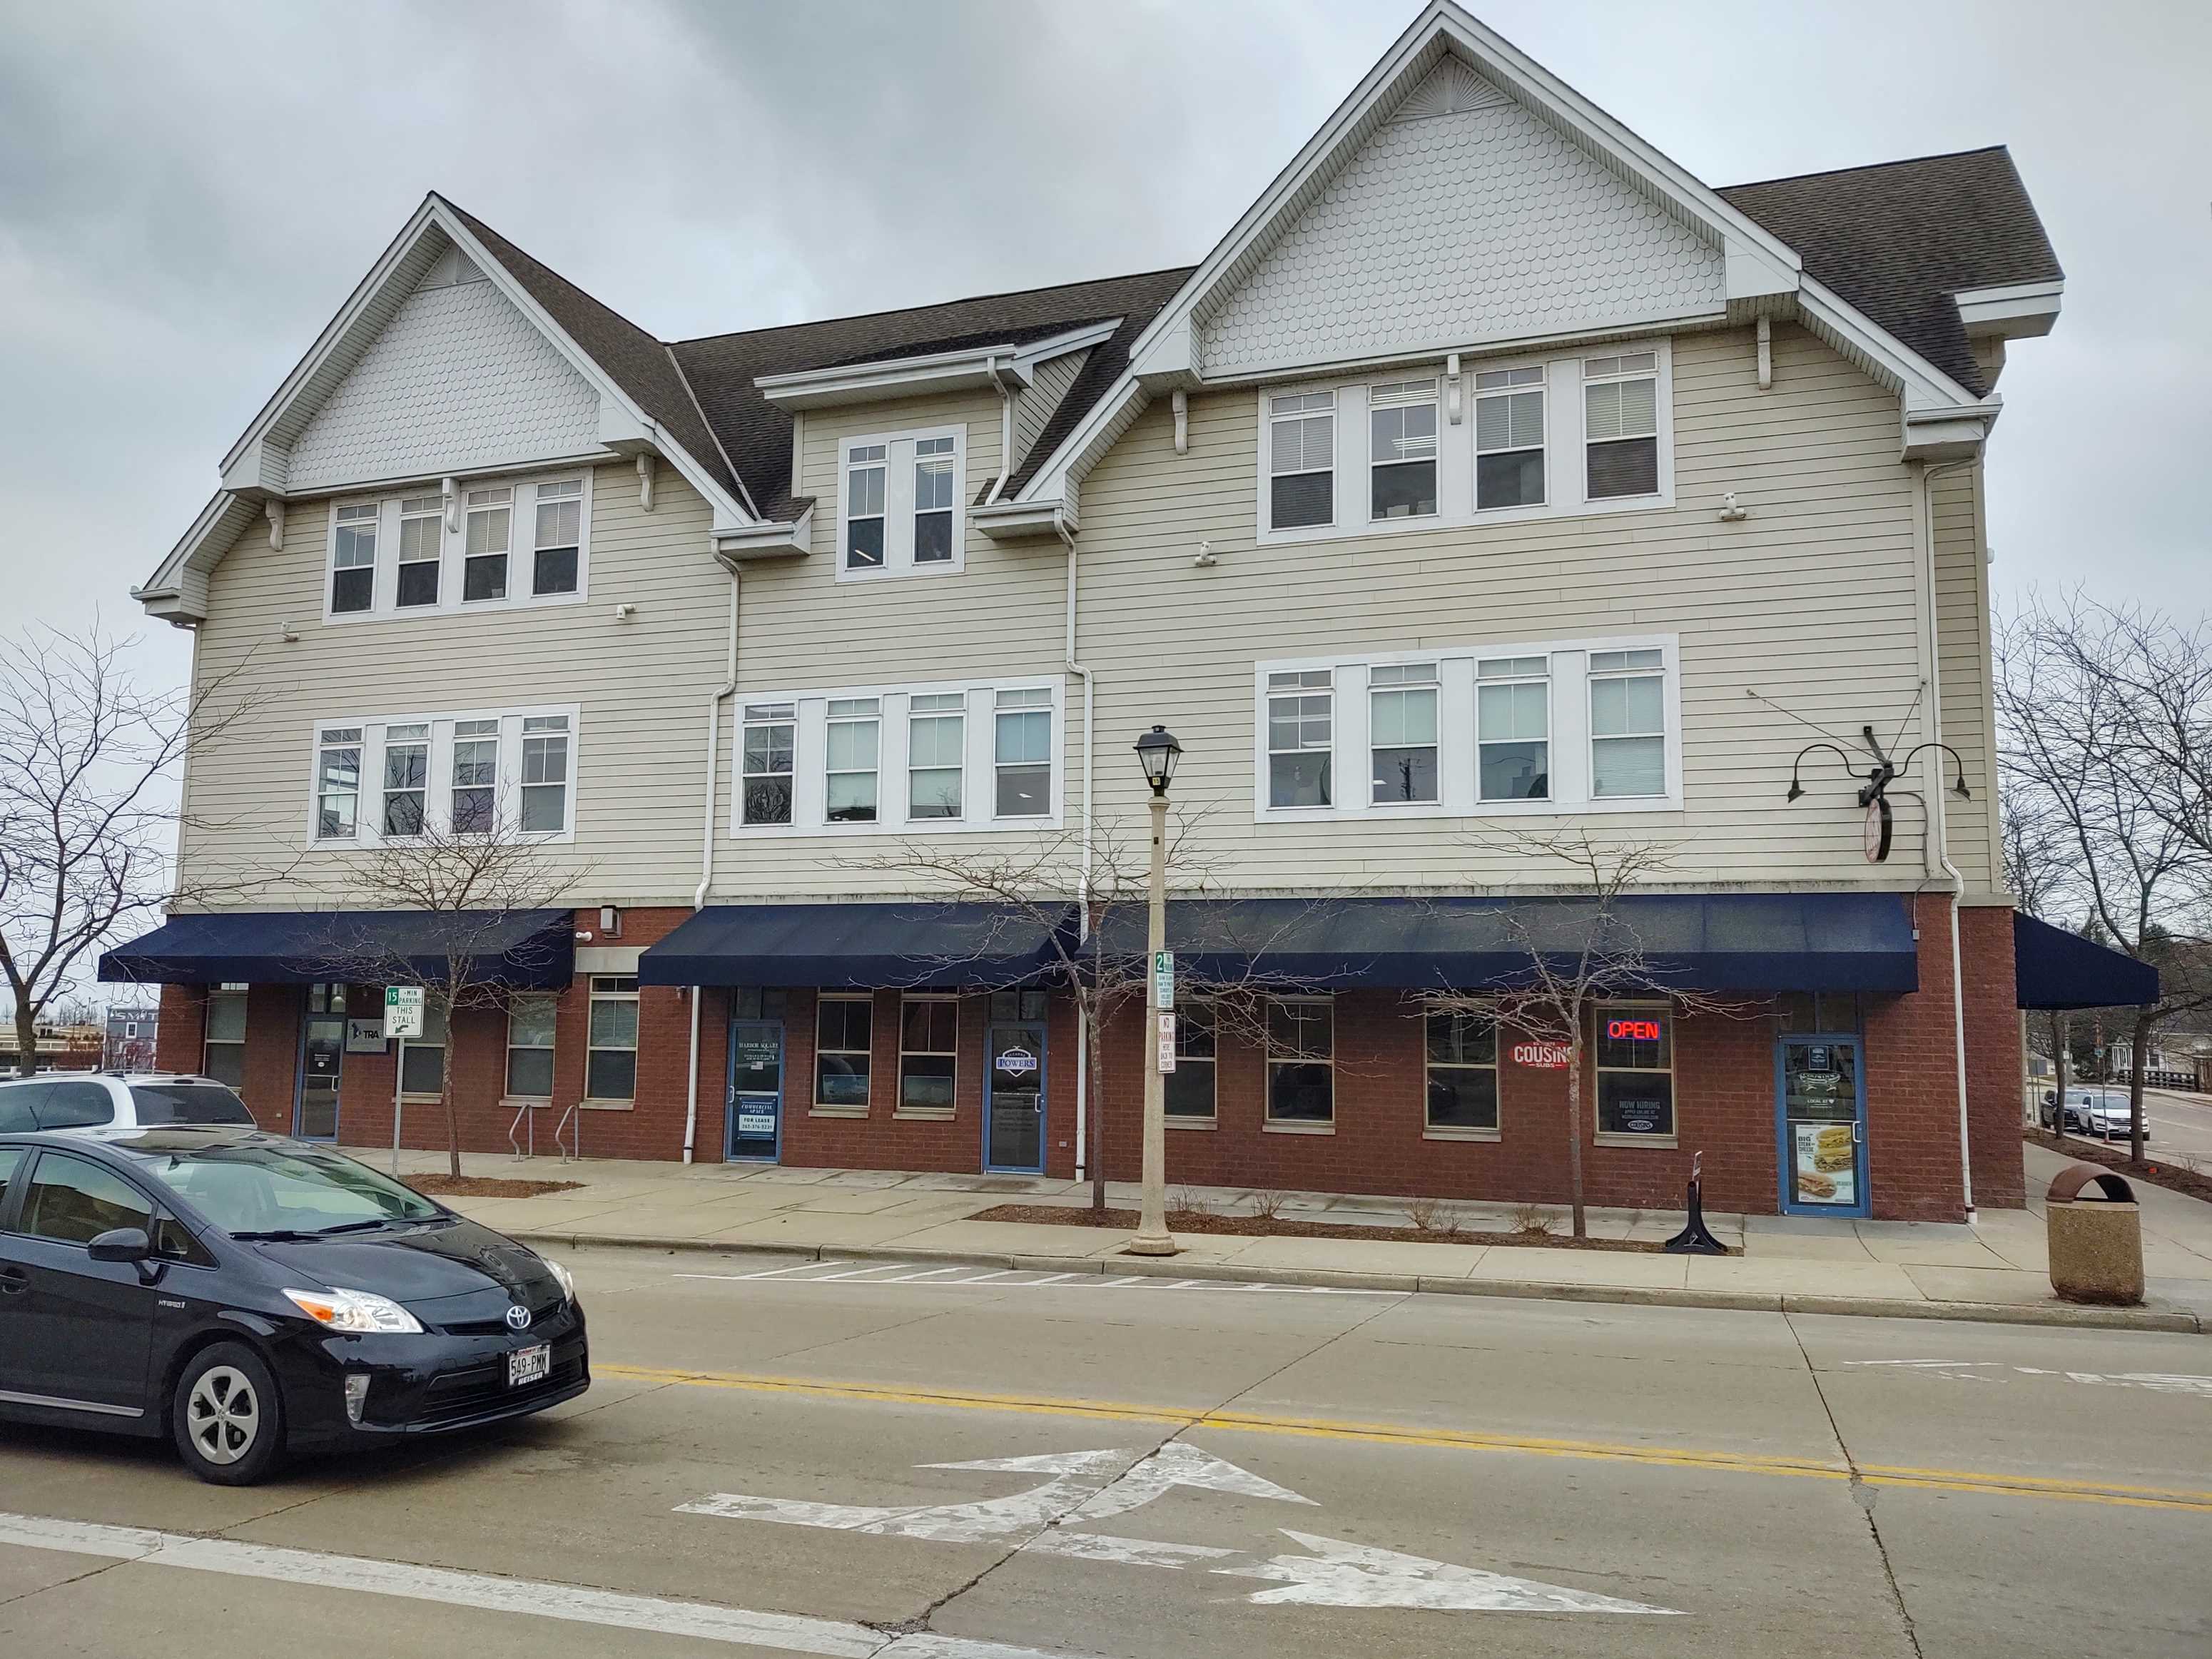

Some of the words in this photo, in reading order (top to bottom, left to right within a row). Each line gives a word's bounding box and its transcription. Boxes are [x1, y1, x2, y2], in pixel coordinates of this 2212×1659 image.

[1157, 955, 1163, 970] 2
[388, 992, 397, 1002] 15
[1163, 1017, 1170, 1028] NO
[363, 1030, 379, 1039] TRA
[1609, 1021, 1658, 1039] OPEN
